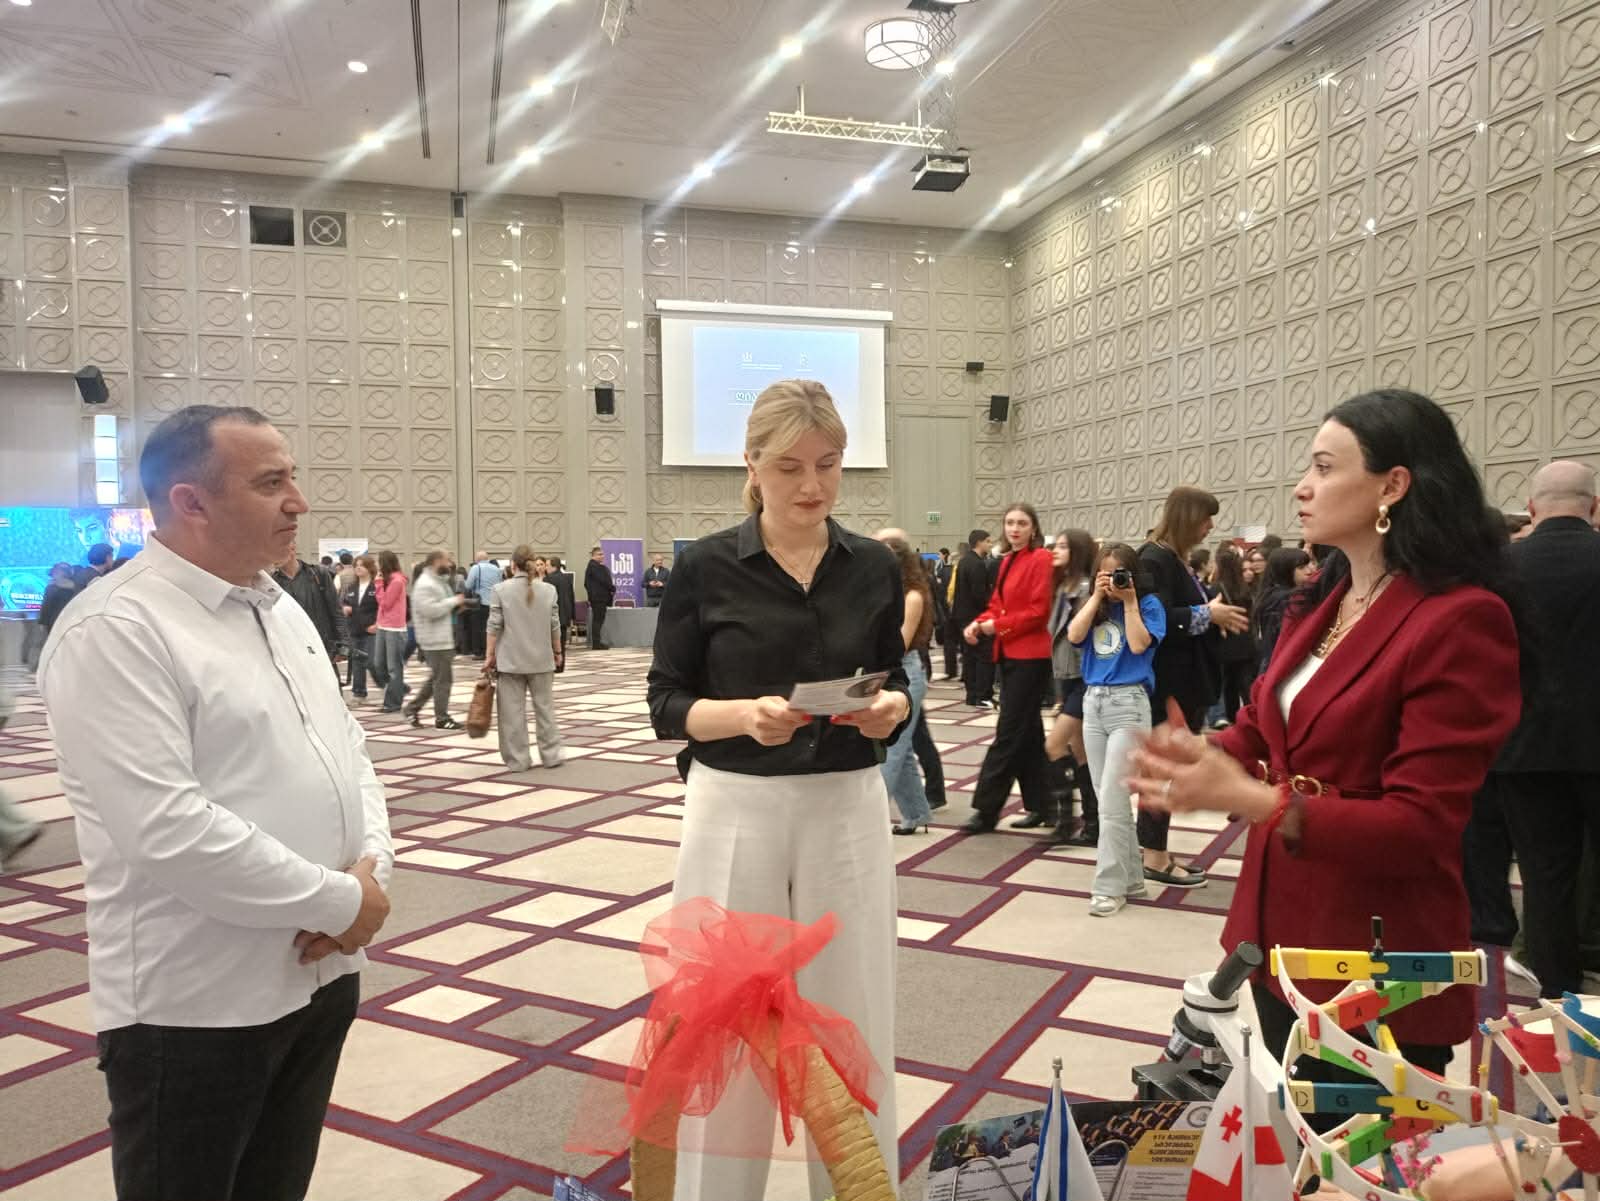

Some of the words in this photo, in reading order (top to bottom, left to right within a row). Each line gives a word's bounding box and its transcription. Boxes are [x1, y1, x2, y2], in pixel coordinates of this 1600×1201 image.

[612, 578, 634, 586] 1922
[1336, 961, 1349, 974] C
[1412, 959, 1426, 973] G
[1458, 961, 1474, 978] D
[1355, 1007, 1363, 1019] A
[1400, 985, 1407, 1000] T
[1352, 1048, 1373, 1068] P
[1295, 1091, 1309, 1107] D
[1335, 1094, 1349, 1108] G
[1416, 1099, 1430, 1112] C
[1436, 1090, 1454, 1105] P
[1366, 1141, 1374, 1153] T
